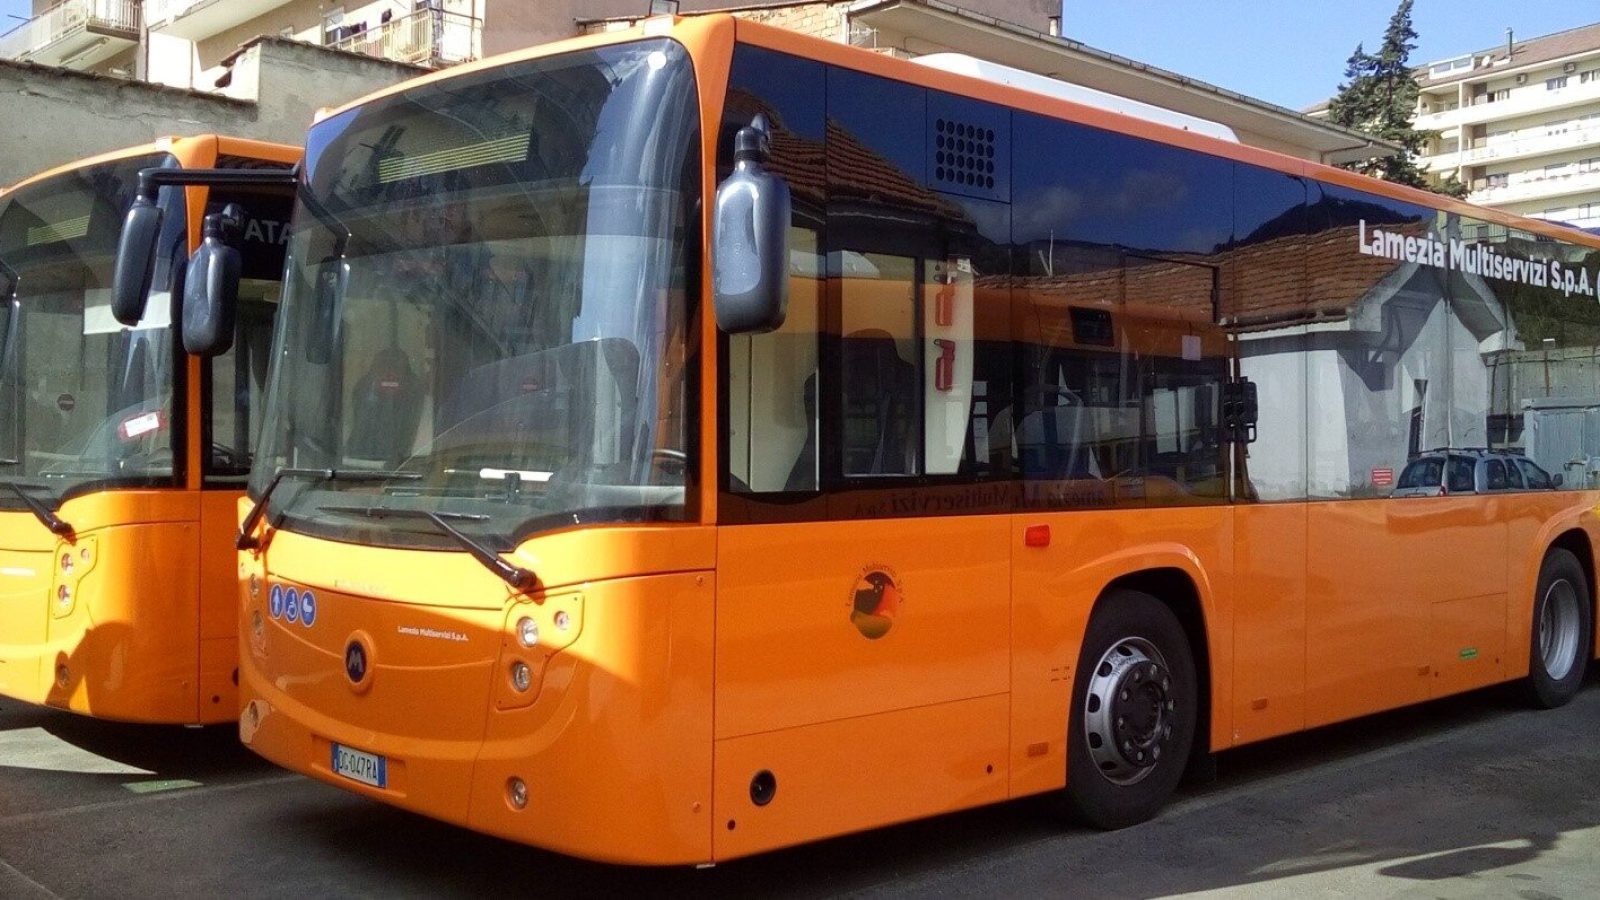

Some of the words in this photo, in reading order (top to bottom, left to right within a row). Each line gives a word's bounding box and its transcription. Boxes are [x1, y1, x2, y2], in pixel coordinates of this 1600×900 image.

[1359, 219, 1444, 268] Lamezia
[1450, 238, 1547, 288] Multiservizi
[1551, 263, 1594, 298] S.p.A.
